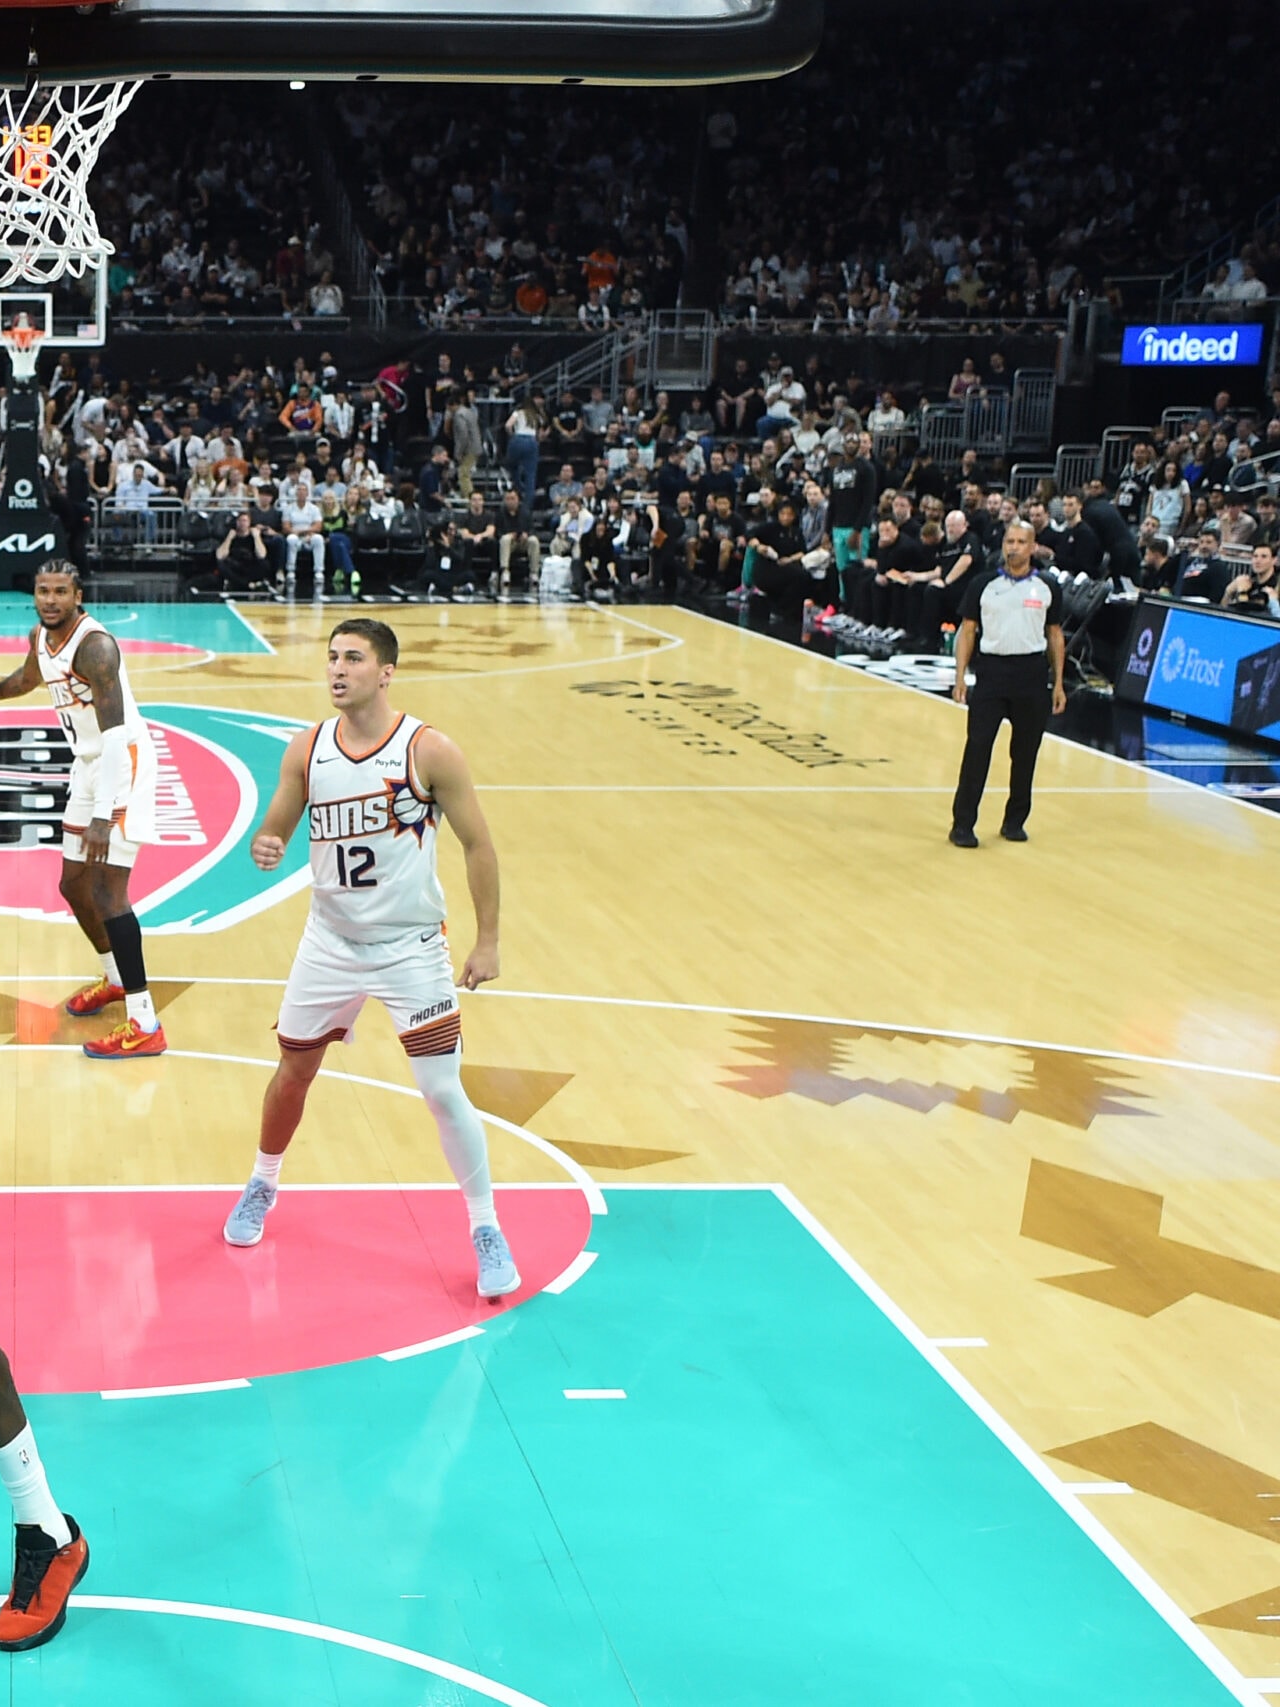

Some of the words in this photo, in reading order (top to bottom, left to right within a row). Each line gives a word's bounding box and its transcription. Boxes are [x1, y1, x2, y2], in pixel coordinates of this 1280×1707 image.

[1143, 330, 1238, 361] indeed
[8, 497, 37, 509] Frost
[1182, 647, 1224, 687] Frost
[374, 758, 402, 769] PayPal
[310, 798, 390, 840] SUNS
[336, 843, 378, 888] 12
[409, 999, 454, 1028] PHOENIX
